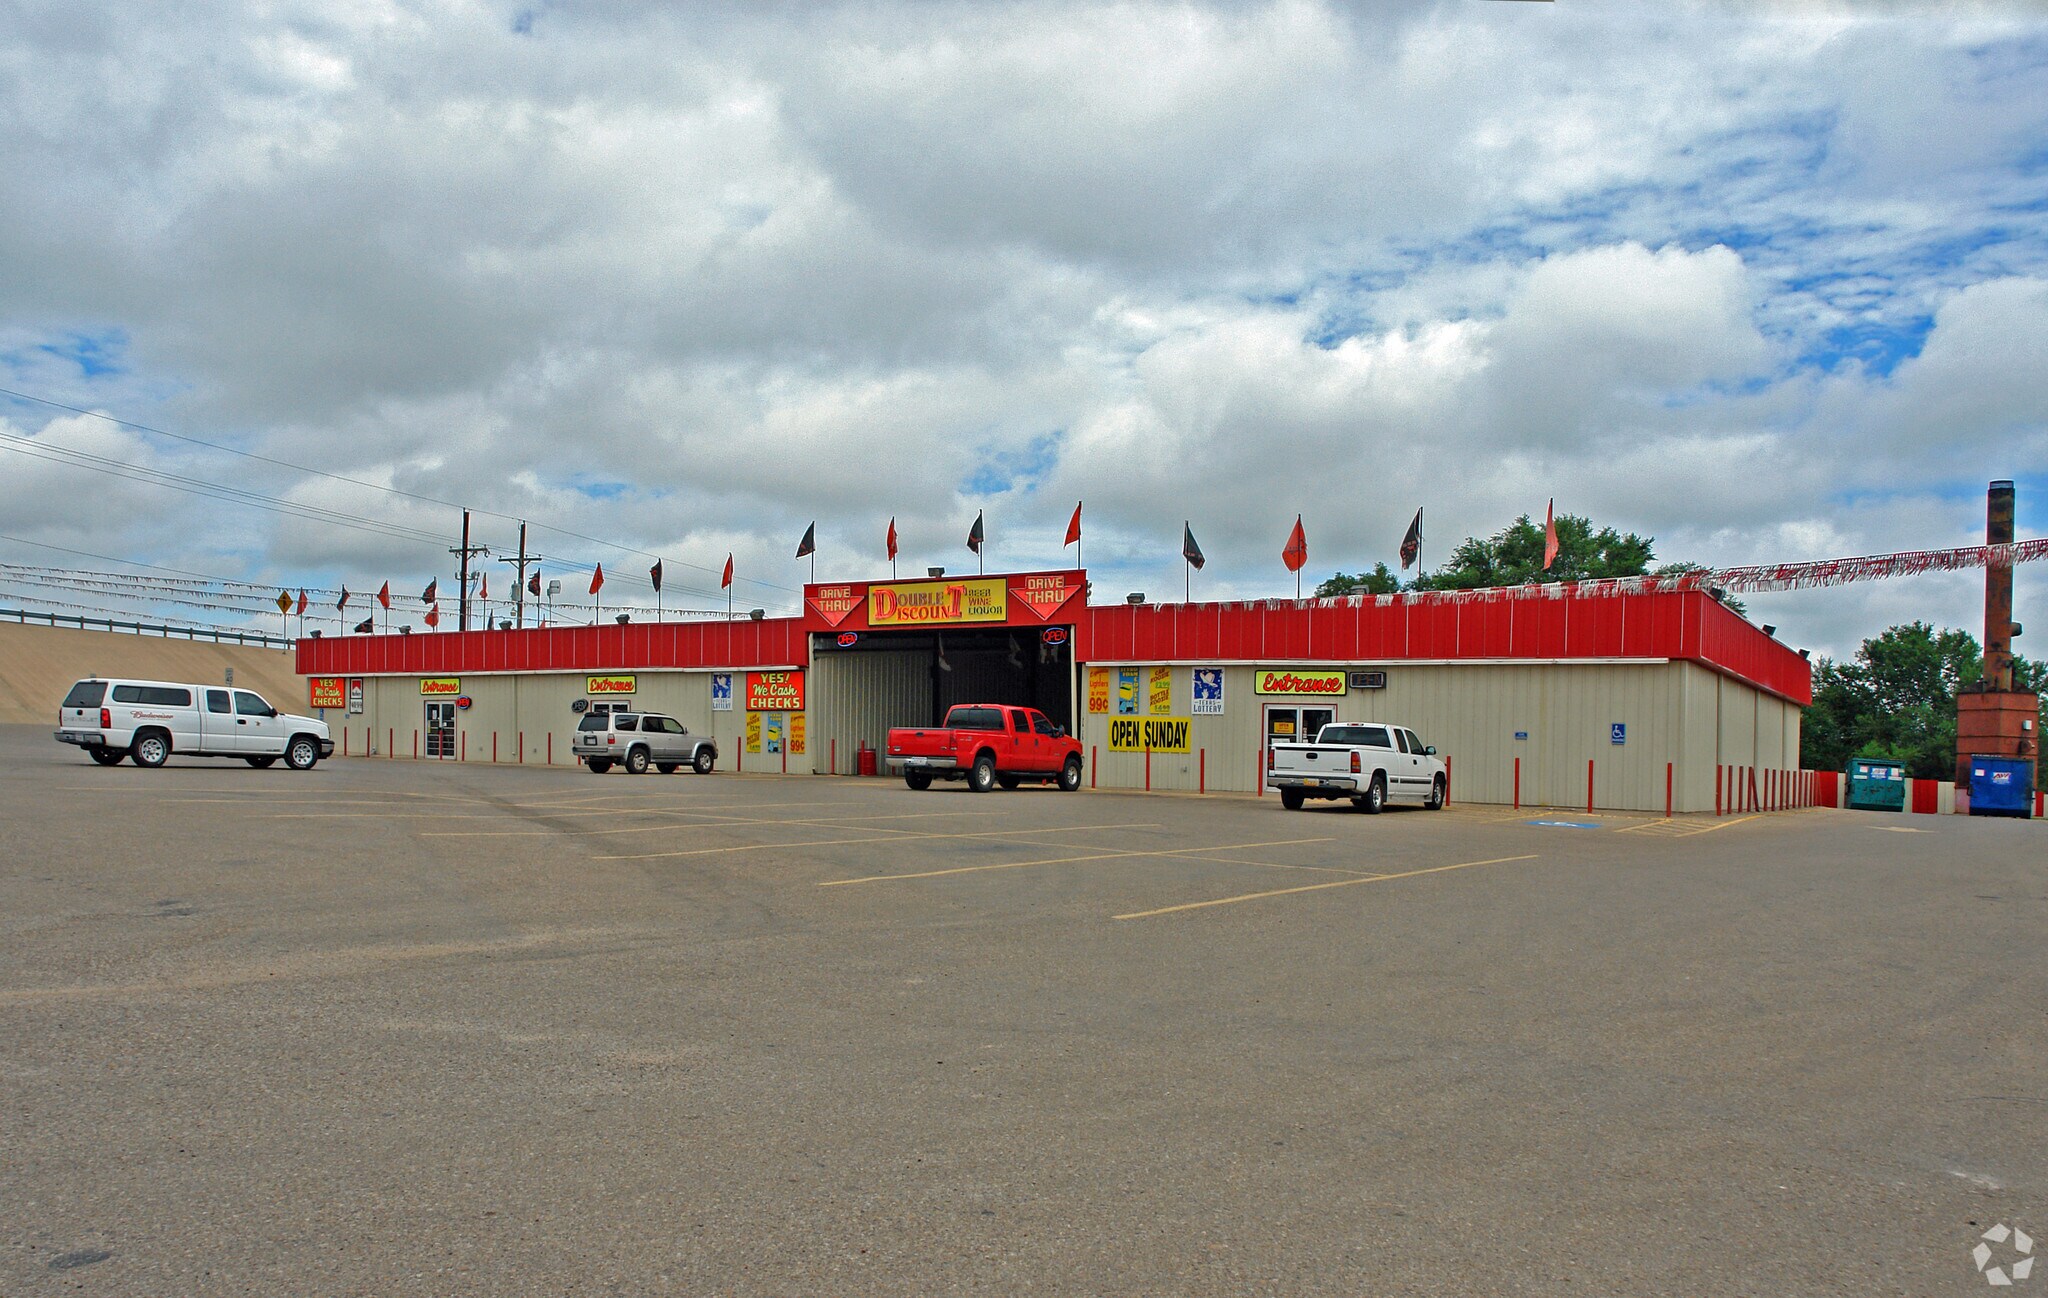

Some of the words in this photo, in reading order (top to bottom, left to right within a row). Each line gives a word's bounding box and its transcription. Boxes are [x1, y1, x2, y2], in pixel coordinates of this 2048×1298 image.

[1027, 578, 1063, 590] DRIVE
[820, 589, 850, 599] DRIVE
[968, 588, 991, 597] BEER
[1025, 590, 1065, 604] THRU
[818, 600, 850, 612] THRU
[968, 597, 991, 606] WINE
[968, 606, 1003, 615] LIQUOR
[837, 633, 856, 645] OPEN
[1042, 630, 1067, 643] OPEN
[319, 679, 337, 687] YES!
[761, 673, 790, 683] YES!
[1263, 673, 1343, 693] Entrance
[590, 678, 635, 692] Entrance
[752, 684, 768, 696] We
[770, 684, 797, 696] Cash
[313, 698, 342, 706] CHECKS
[750, 698, 800, 708] CHECKS
[1089, 697, 1108, 711] 99¢
[1193, 704, 1222, 713] LOTTERY
[130, 711, 174, 719] Budweiser
[1112, 720, 1139, 747] OPEN
[1144, 720, 1188, 748] SUNDAY
